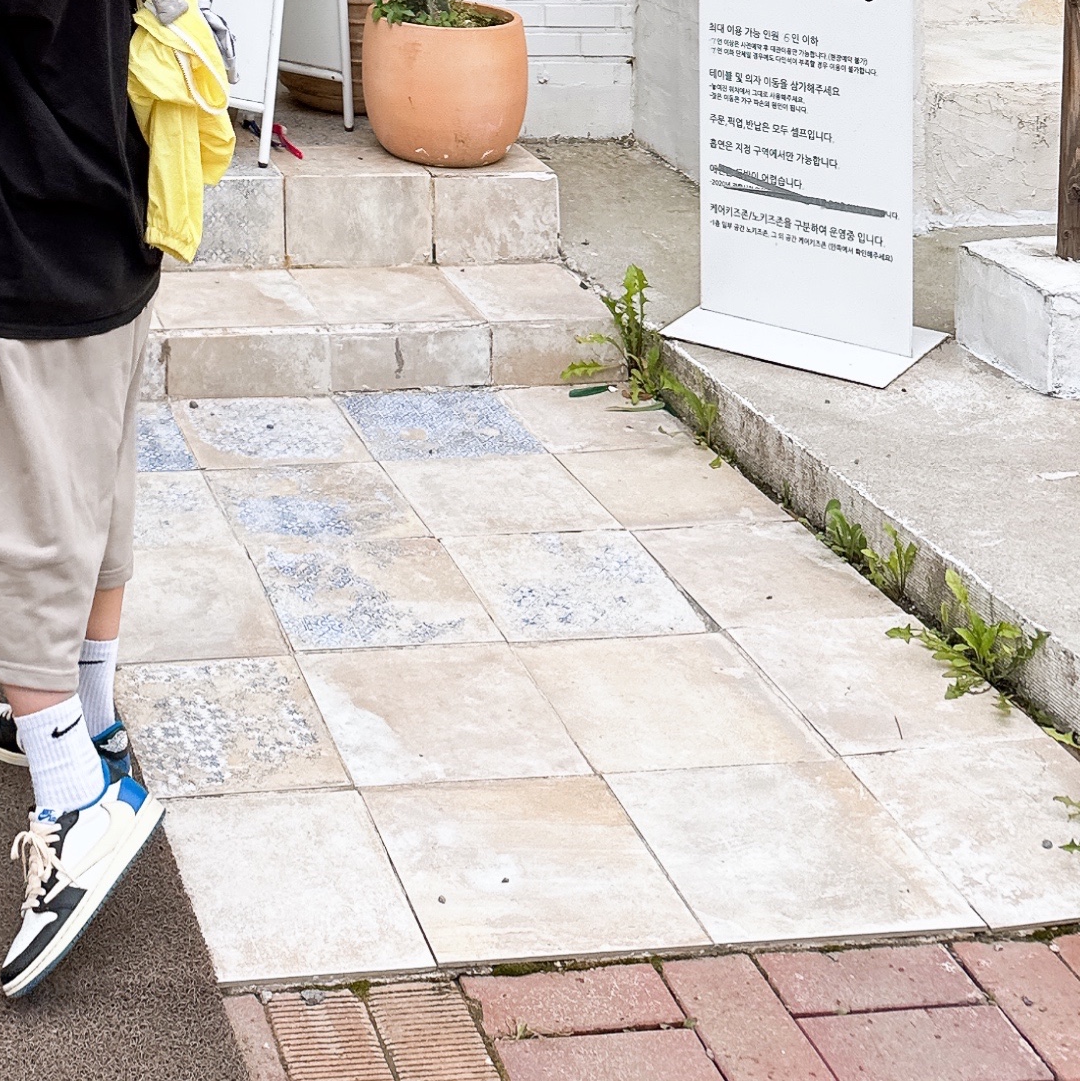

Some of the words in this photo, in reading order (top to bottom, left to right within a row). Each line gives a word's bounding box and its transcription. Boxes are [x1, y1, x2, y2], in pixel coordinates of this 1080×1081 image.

[709, 22, 725, 34] 최대
[726, 24, 743, 37] 이용
[745, 27, 761, 39] 가능
[763, 29, 779, 42] 인원
[801, 34, 819, 47] 이하
[709, 68, 733, 82] 테이블
[735, 72, 743, 84] 및
[745, 73, 761, 86] 의자
[763, 76, 788, 90] 이동을
[790, 80, 841, 97] 삼가해주세요
[771, 123, 789, 136] 모두
[709, 138, 733, 152] 흡연은
[735, 142, 751, 155] 지정
[753, 145, 795, 163] 구역에서만
[796, 152, 840, 169] 가능합니다.
[721, 221, 733, 230] 일부
[733, 223, 745, 233] 공간
[785, 233, 797, 243] 공간
[793, 219, 828, 237] 구분하여
[828, 226, 856, 243] 운영중
[857, 232, 886, 248] 입니다.
